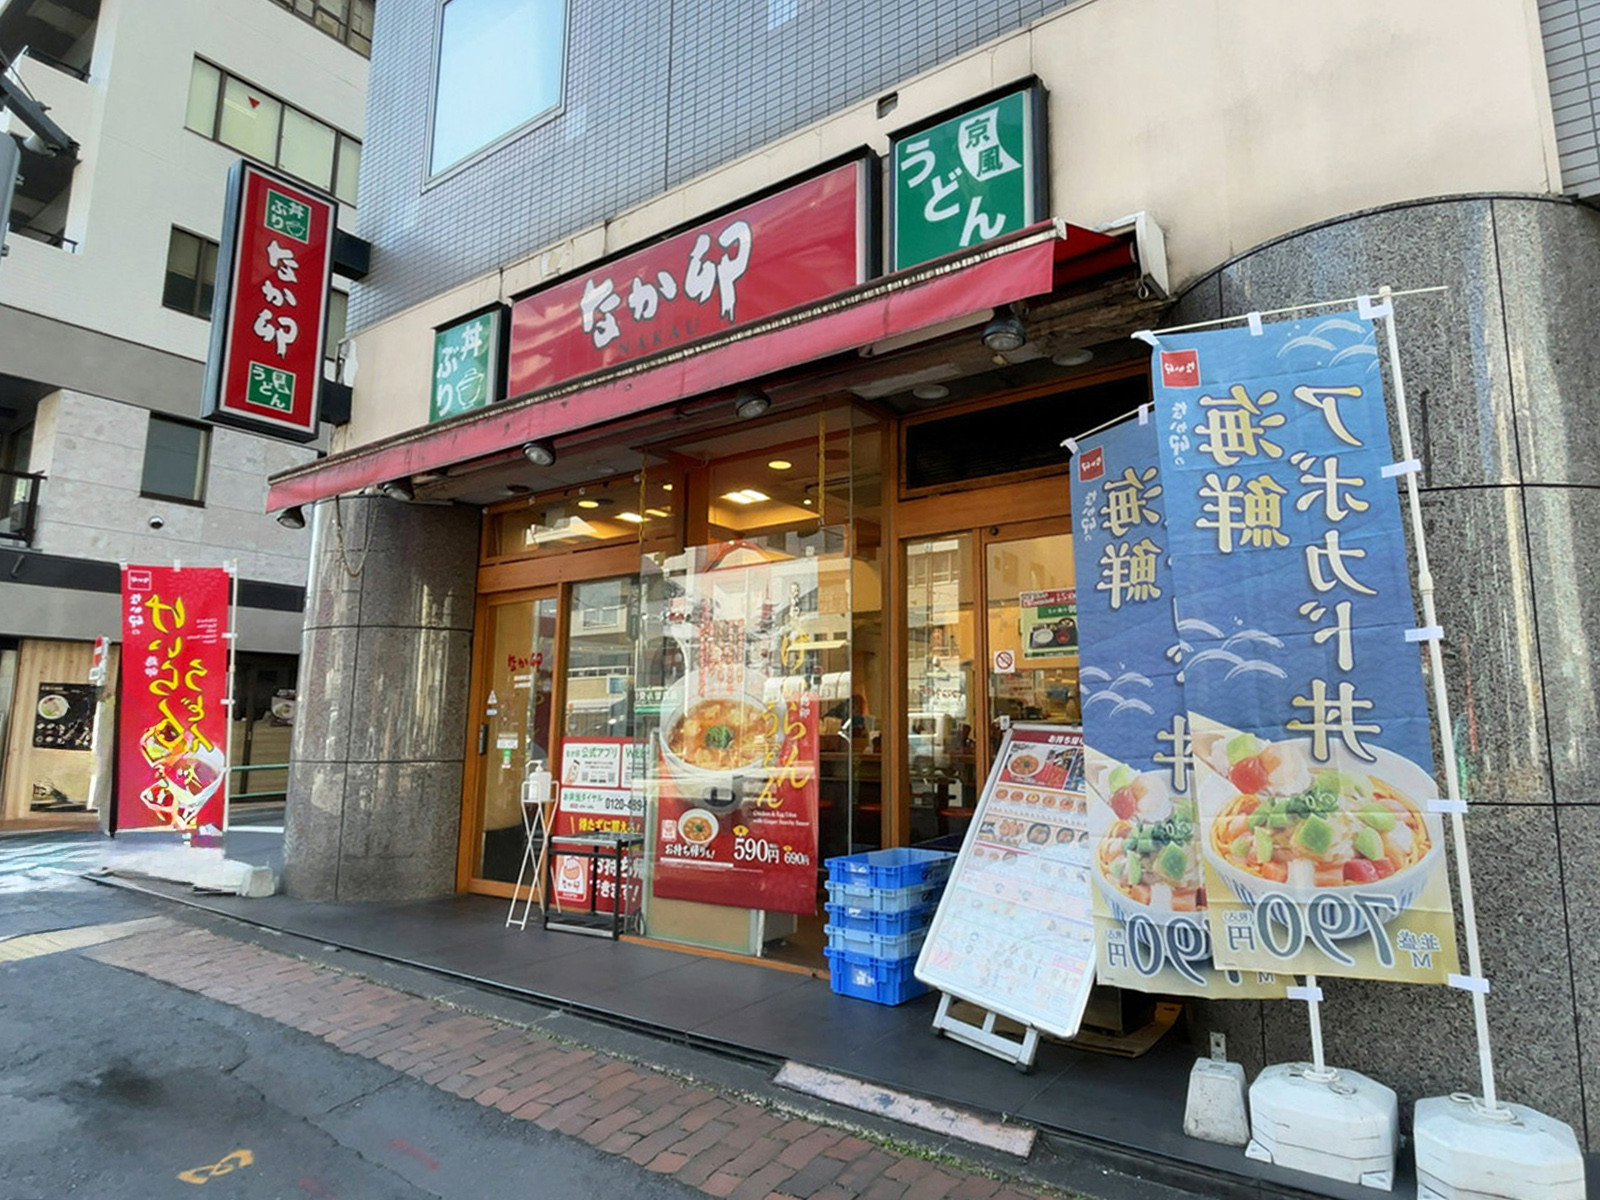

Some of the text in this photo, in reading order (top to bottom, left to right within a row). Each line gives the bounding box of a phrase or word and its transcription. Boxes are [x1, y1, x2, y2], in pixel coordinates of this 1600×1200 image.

[964, 116, 1004, 177] 京風
[900, 137, 1007, 248] うどん
[253, 239, 299, 360] なか卯
[580, 219, 753, 350] なか卯
[252, 365, 286, 409] うどん
[507, 652, 543, 672] なか卯
